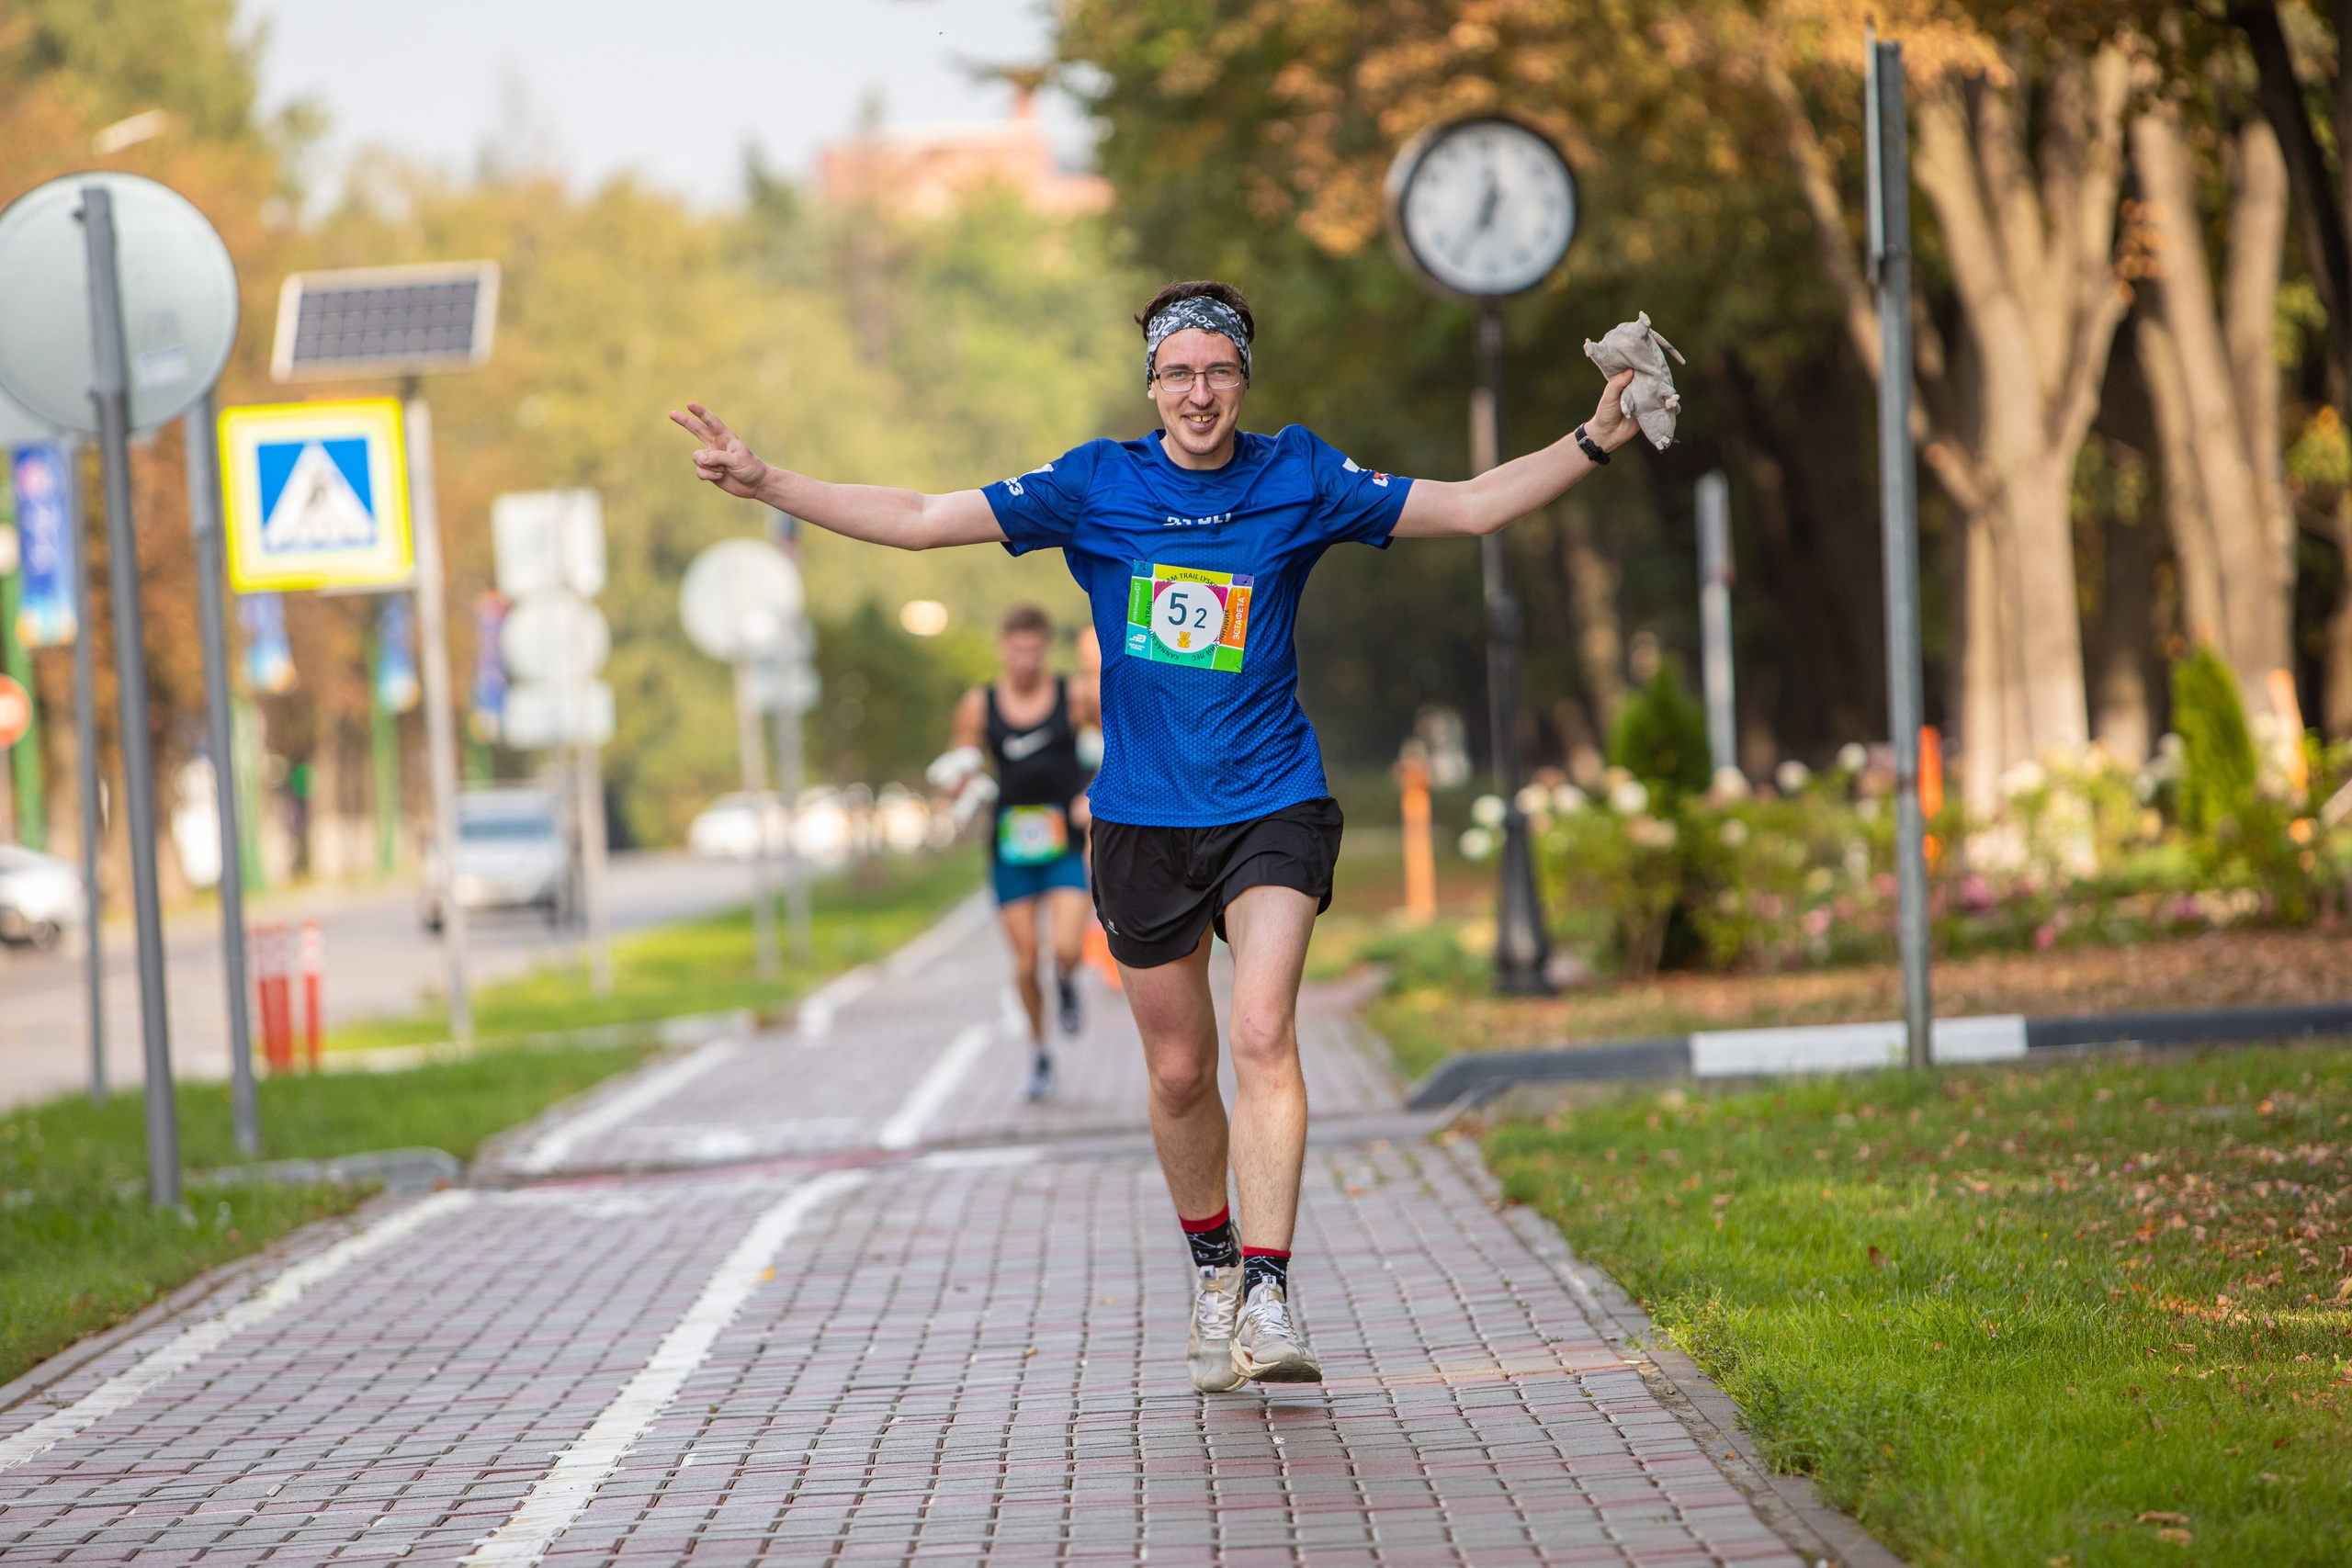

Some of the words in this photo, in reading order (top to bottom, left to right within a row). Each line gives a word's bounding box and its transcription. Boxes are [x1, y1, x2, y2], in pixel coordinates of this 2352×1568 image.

[1155, 574, 1178, 592] DREAM
[1200, 575, 1224, 598] LYSKOVO
[1145, 600, 1153, 619] TRAIL
[1232, 596, 1246, 640] ЭСТАФЕТА
[1205, 609, 1229, 657] ХИМКИНСКИЙ
[1154, 640, 1180, 660] KANNAS
[1191, 652, 1204, 661] ЛЕС
